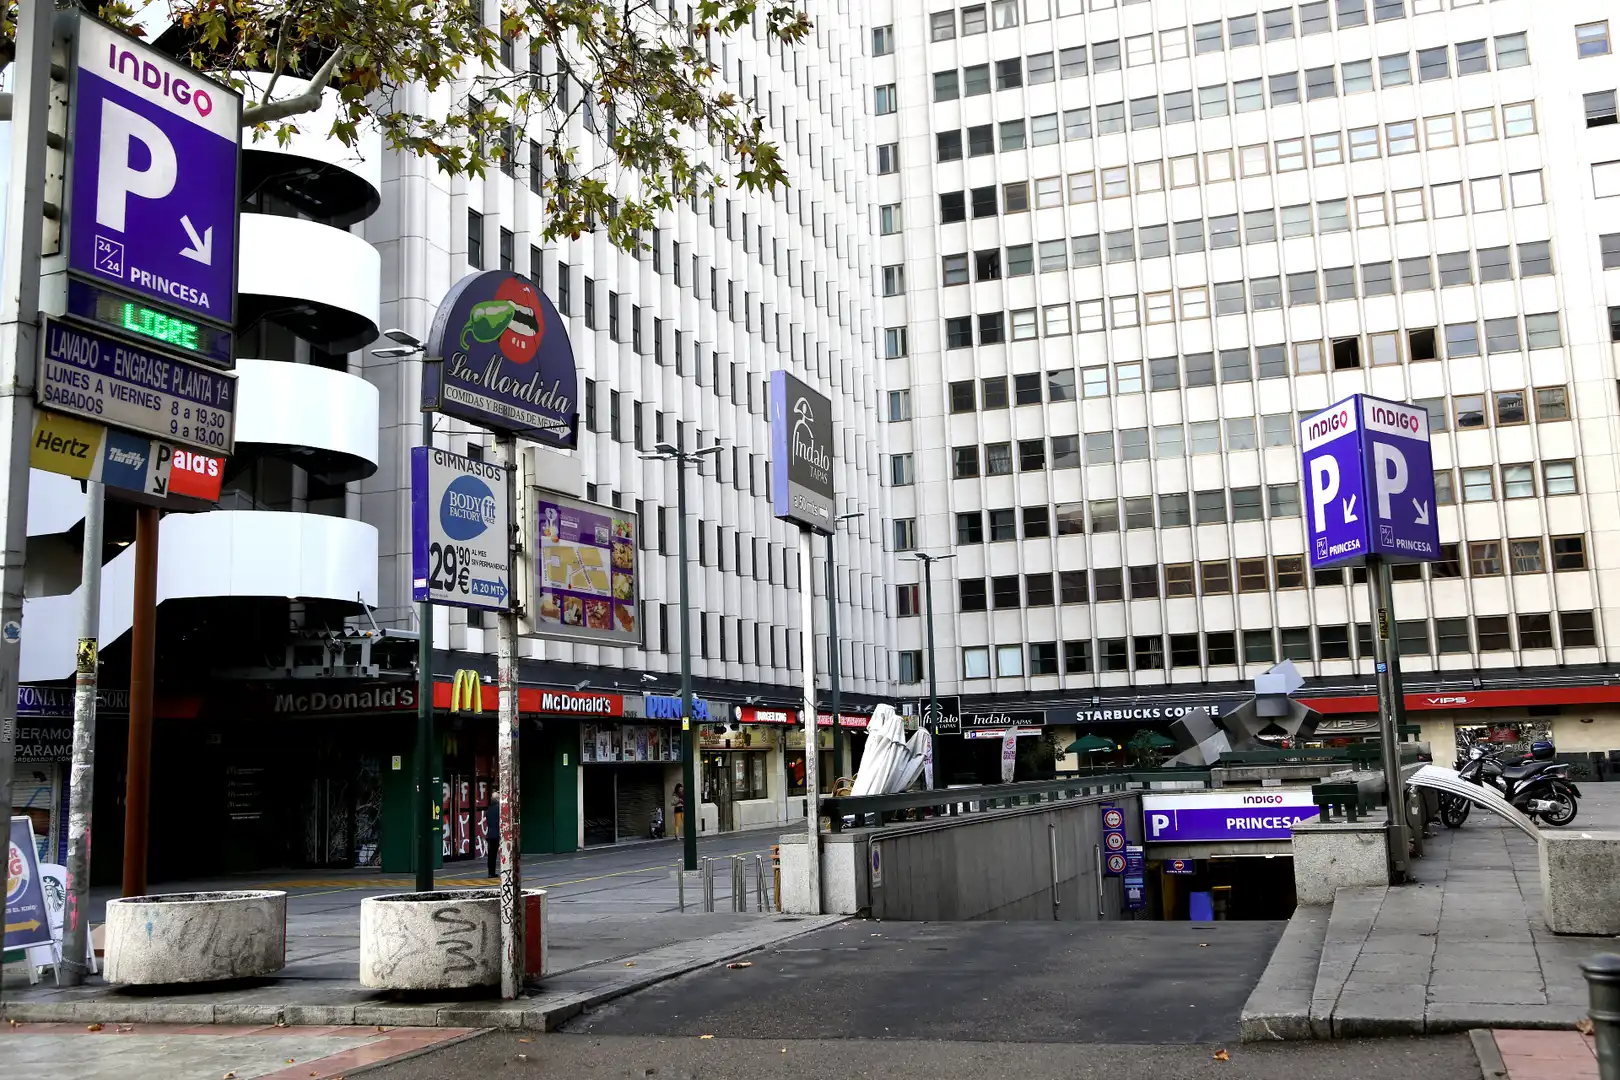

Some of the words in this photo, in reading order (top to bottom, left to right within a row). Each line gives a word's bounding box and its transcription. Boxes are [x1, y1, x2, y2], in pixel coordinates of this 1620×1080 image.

[109, 43, 213, 117] INDIGO
[96, 97, 178, 233] P
[130, 266, 210, 308] PRINCESA
[123, 302, 198, 350] LIBRE
[50, 327, 99, 369] LAVADO
[113, 347, 169, 390] ENGRASE
[172, 370, 212, 402] PLANTA
[46, 363, 90, 391] LUNES
[94, 378, 104, 395] A
[109, 381, 162, 411] VIERNES
[170, 401, 179, 416] 8
[183, 408, 190, 420] a
[474, 353, 573, 414] Mordida
[44, 383, 104, 415] SABADOS
[170, 419, 178, 434] 9
[182, 425, 189, 437] a
[446, 386, 486, 408] COMIDAS
[485, 398, 492, 410] Y
[492, 399, 525, 421] BEBIDAS
[526, 410, 537, 424] DE
[1308, 410, 1348, 441] INDIGO
[1372, 406, 1419, 434] INDIGO
[35, 429, 90, 459] Hertz
[794, 431, 831, 472] Indalo
[109, 447, 146, 471] Thrifty
[156, 444, 171, 471] P
[434, 451, 501, 482] GIMNASIOS
[809, 465, 829, 485] TAPAS
[1373, 441, 1409, 520] P
[449, 490, 482, 512] BODY
[1310, 454, 1340, 534] P
[449, 507, 481, 523] FACTORY
[484, 498, 496, 519] fit
[1329, 538, 1361, 556] PRINCESA
[1396, 538, 1432, 553] PRINCESA
[473, 583, 478, 591] A
[480, 584, 489, 593] 20
[490, 585, 505, 596] MTS
[274, 687, 414, 713] McDonald's
[541, 692, 611, 714] McDonald's
[1427, 696, 1467, 704] VIPS
[973, 713, 1011, 725] Indalo
[1076, 707, 1161, 722] STARBUCKS
[1319, 719, 1368, 728] VIPS
[15, 727, 73, 740] BERAMO
[1243, 795, 1283, 805] INDIGO
[1152, 814, 1170, 837] P
